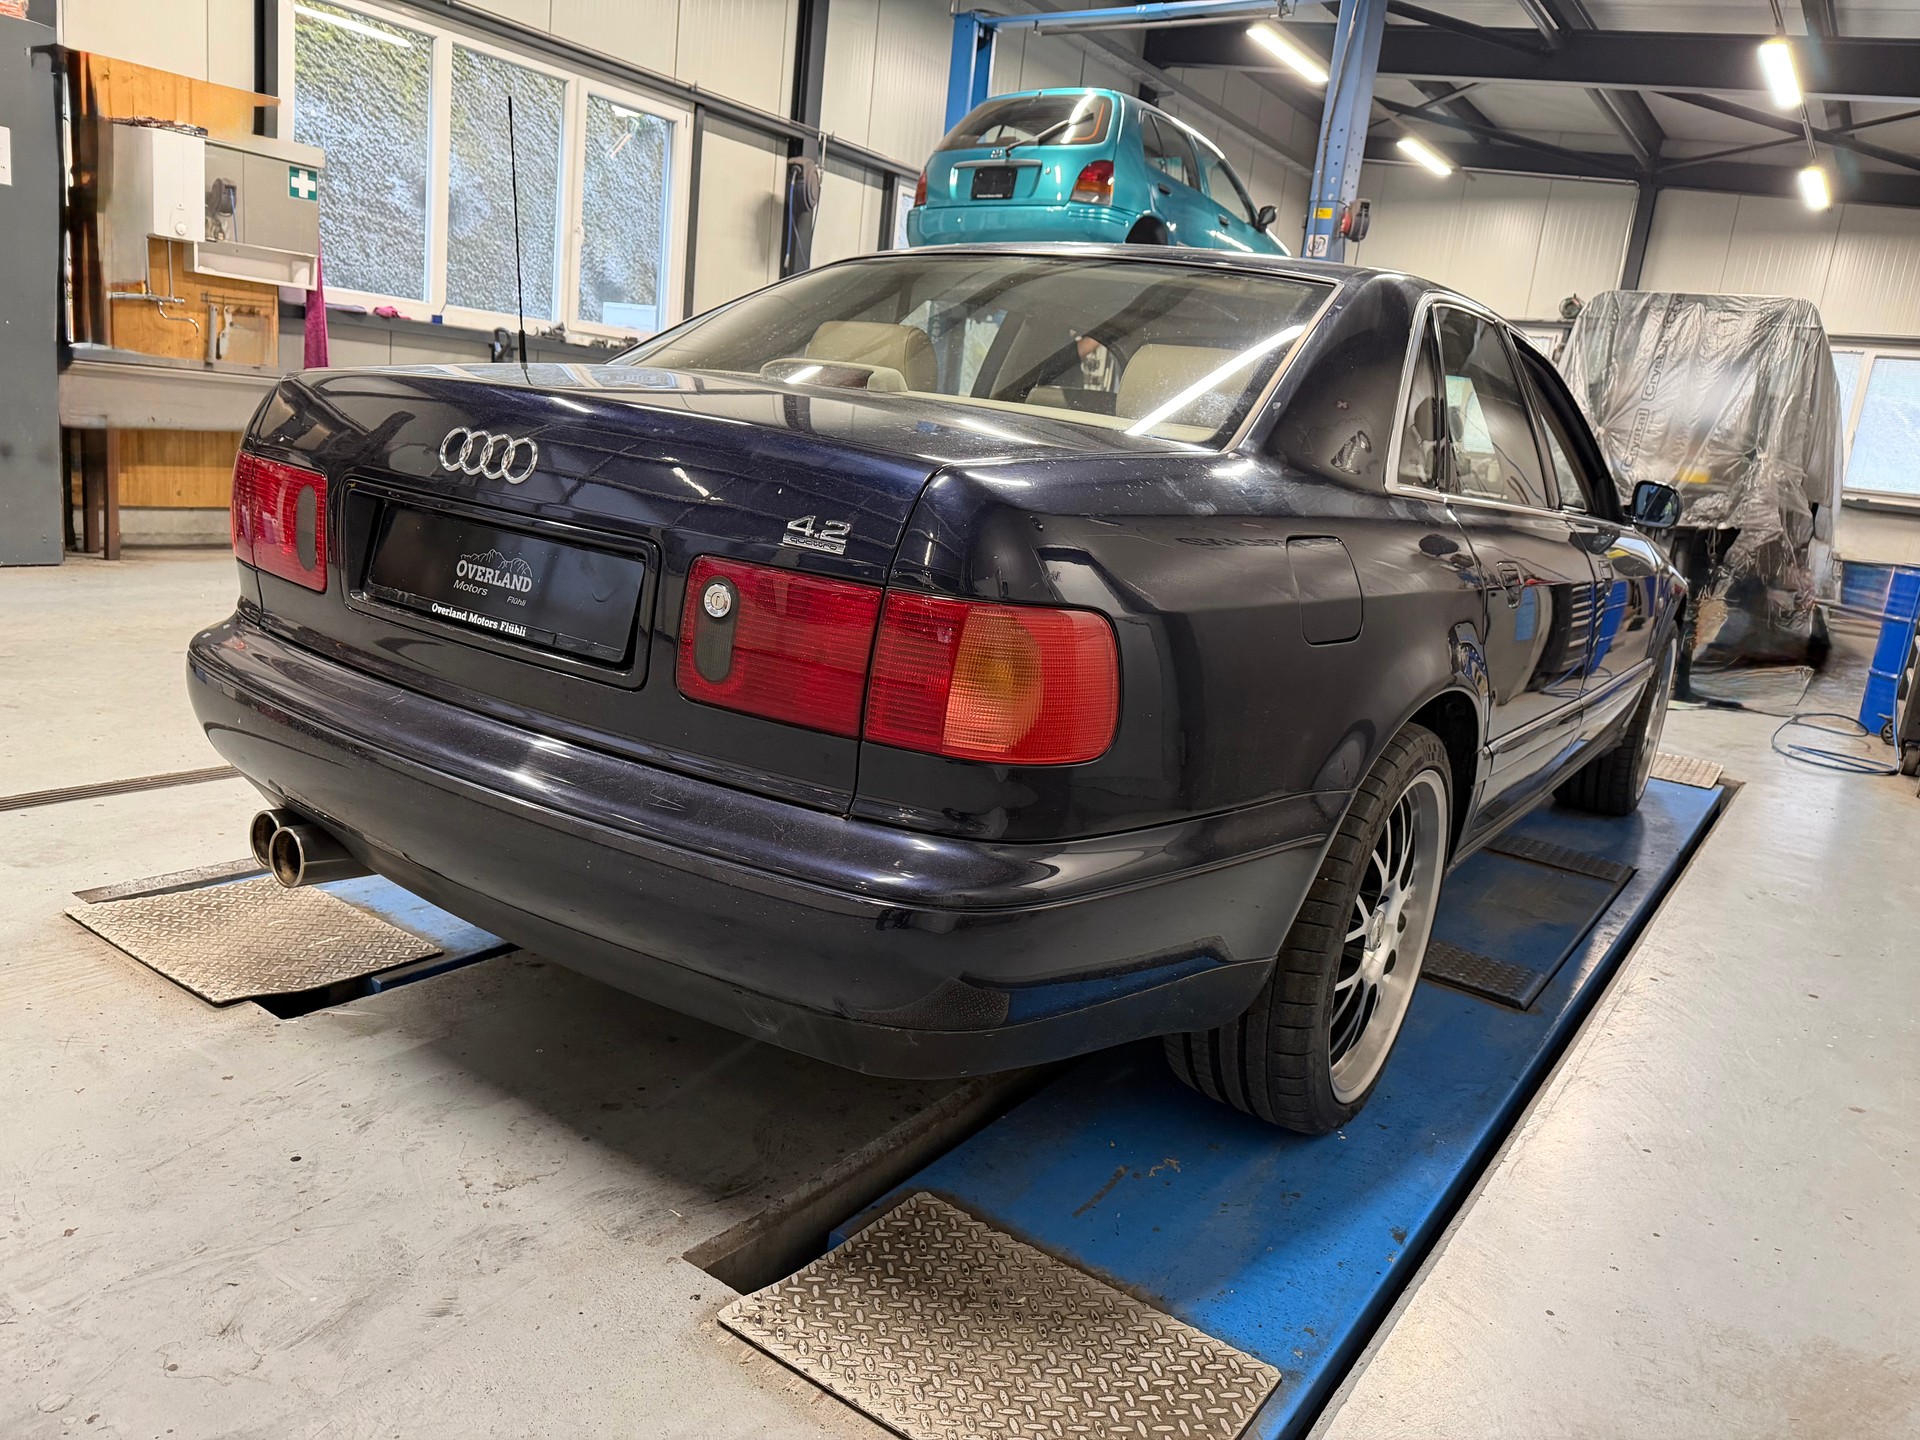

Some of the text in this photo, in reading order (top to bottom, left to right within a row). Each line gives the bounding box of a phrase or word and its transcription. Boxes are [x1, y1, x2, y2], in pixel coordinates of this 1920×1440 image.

[1624, 412, 1647, 468] Crystal
[786, 515, 851, 544] 4.2
[456, 560, 532, 593] OVERLAND
[453, 580, 527, 607] Motors Flühli
[431, 602, 527, 637] Overland Motors Flühli
